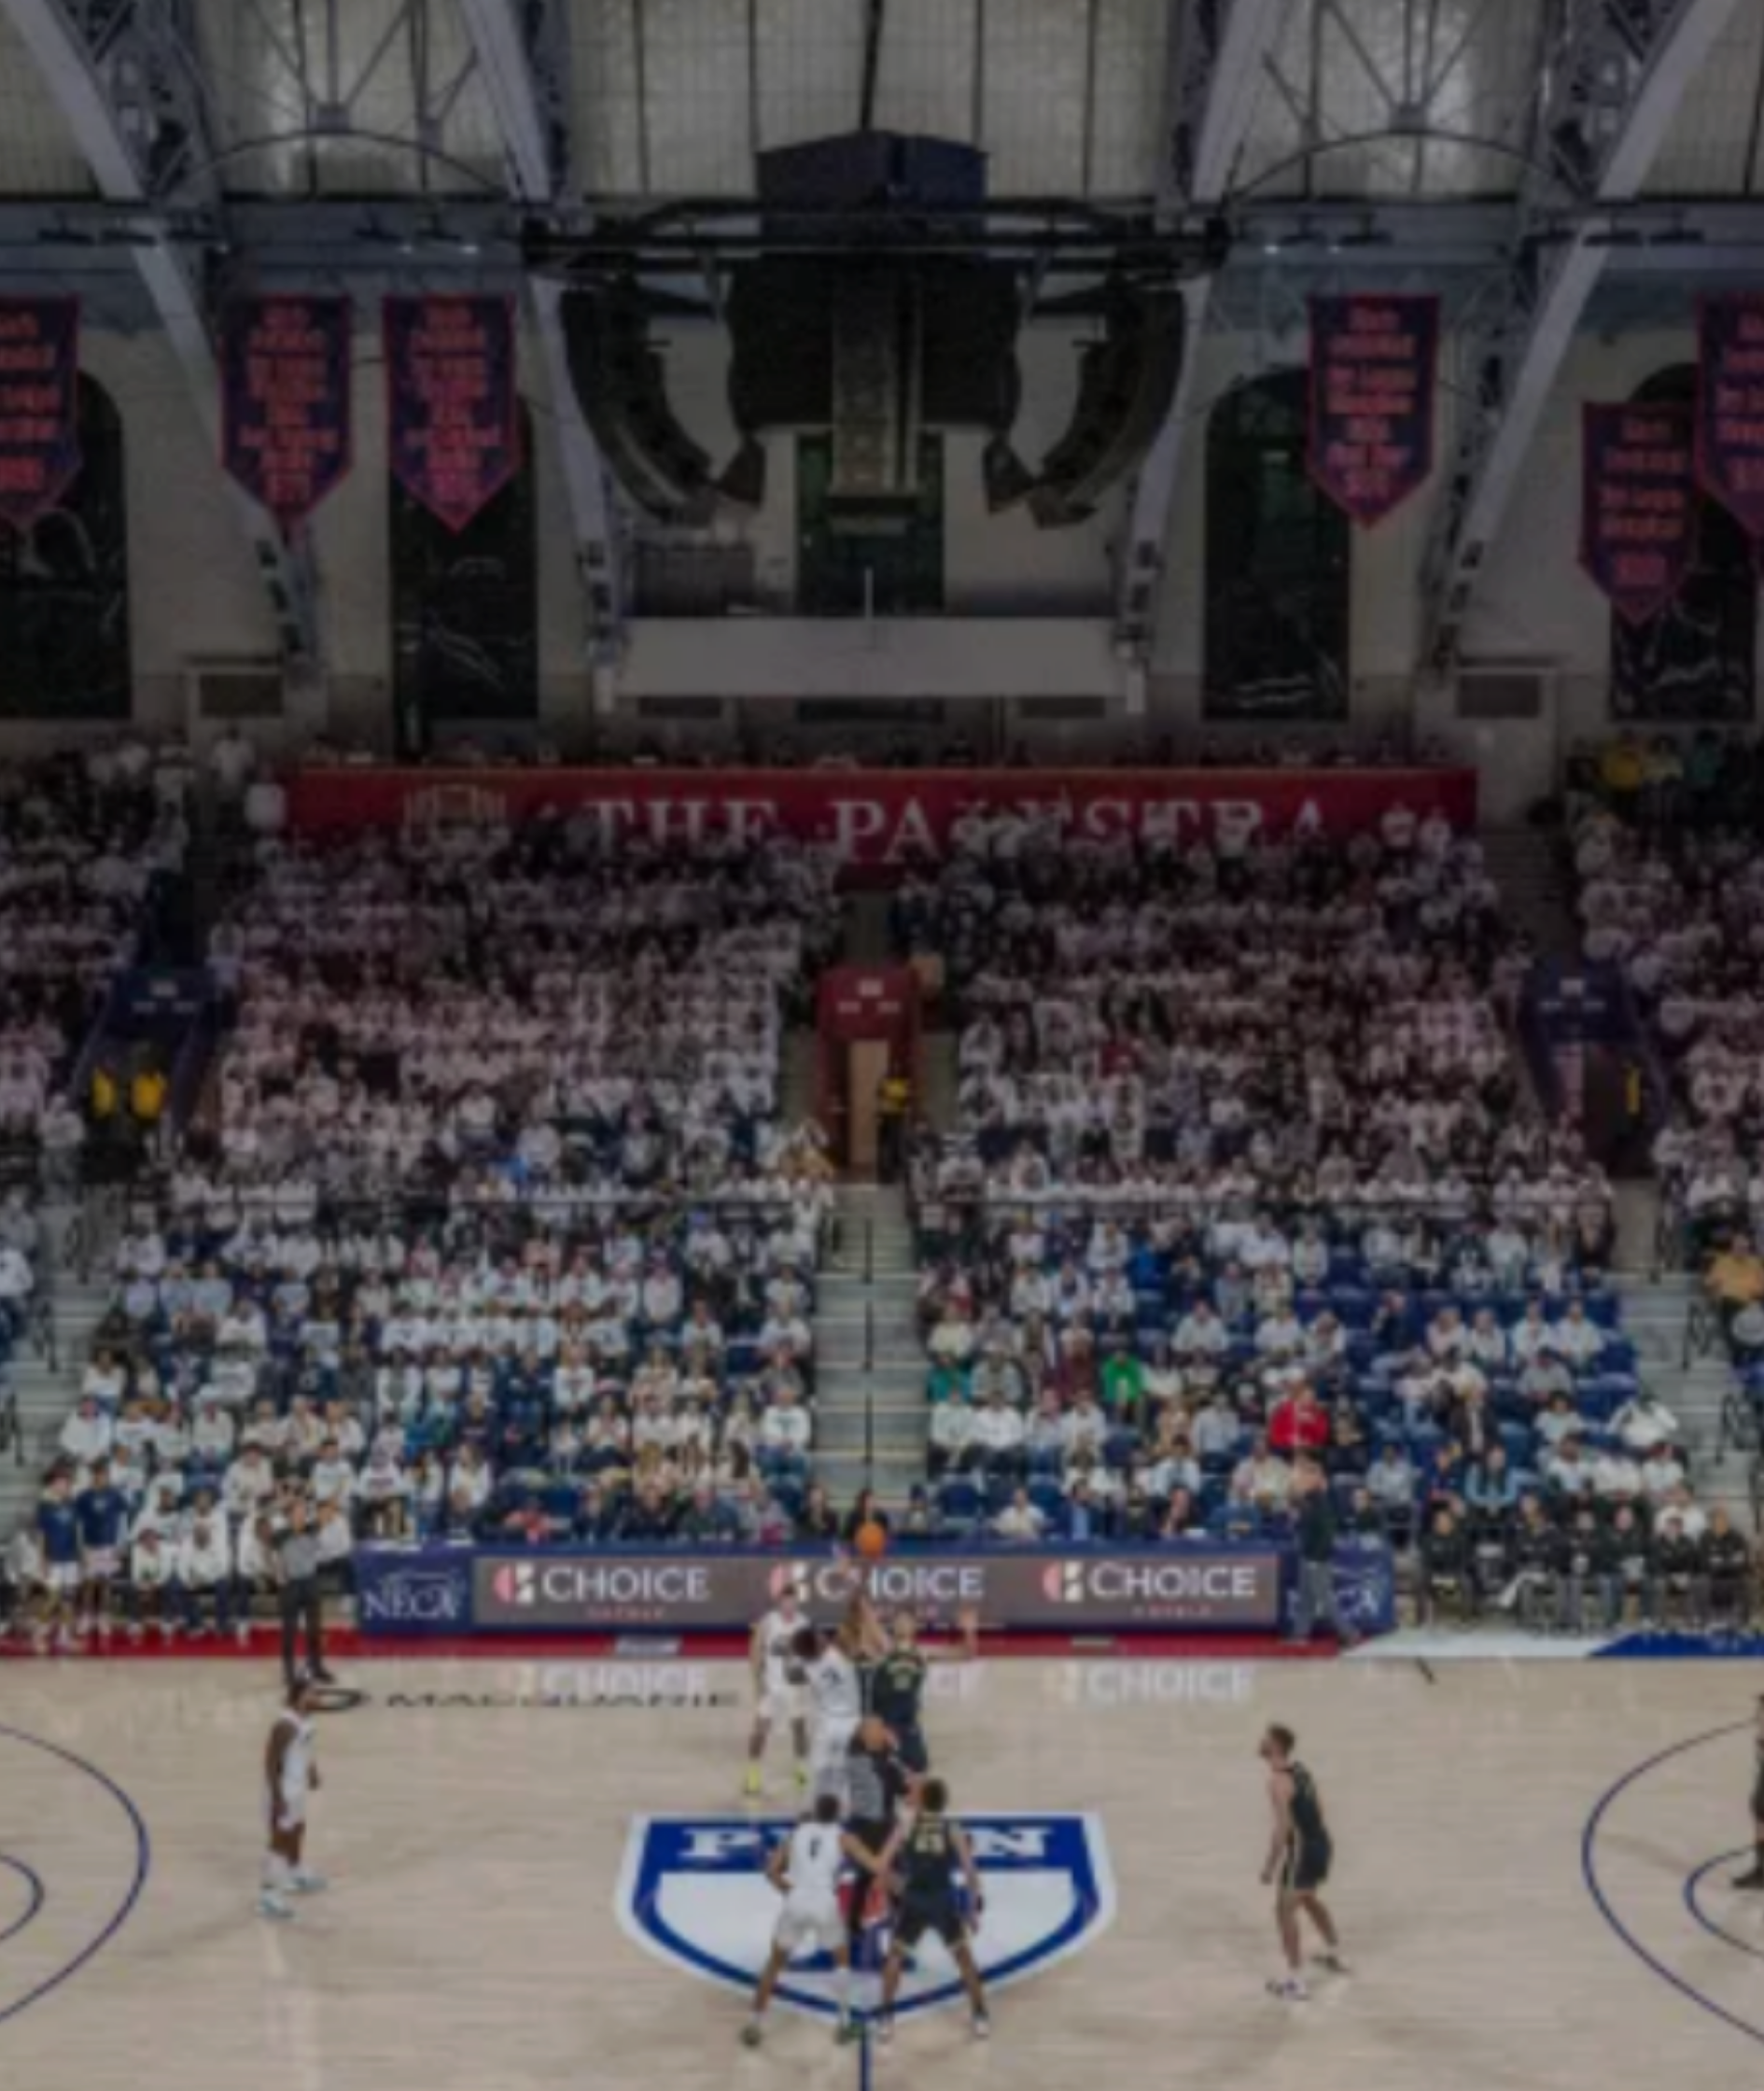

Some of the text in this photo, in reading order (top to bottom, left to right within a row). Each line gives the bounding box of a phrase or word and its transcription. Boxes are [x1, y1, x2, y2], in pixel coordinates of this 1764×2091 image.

[542, 1565, 708, 1602] CHOICE
[814, 1565, 985, 1602] CHOICE
[1089, 1563, 1255, 1599] CHOICE
[1287, 1586, 1380, 1618] NCA
[679, 1827, 1051, 1857] PN
